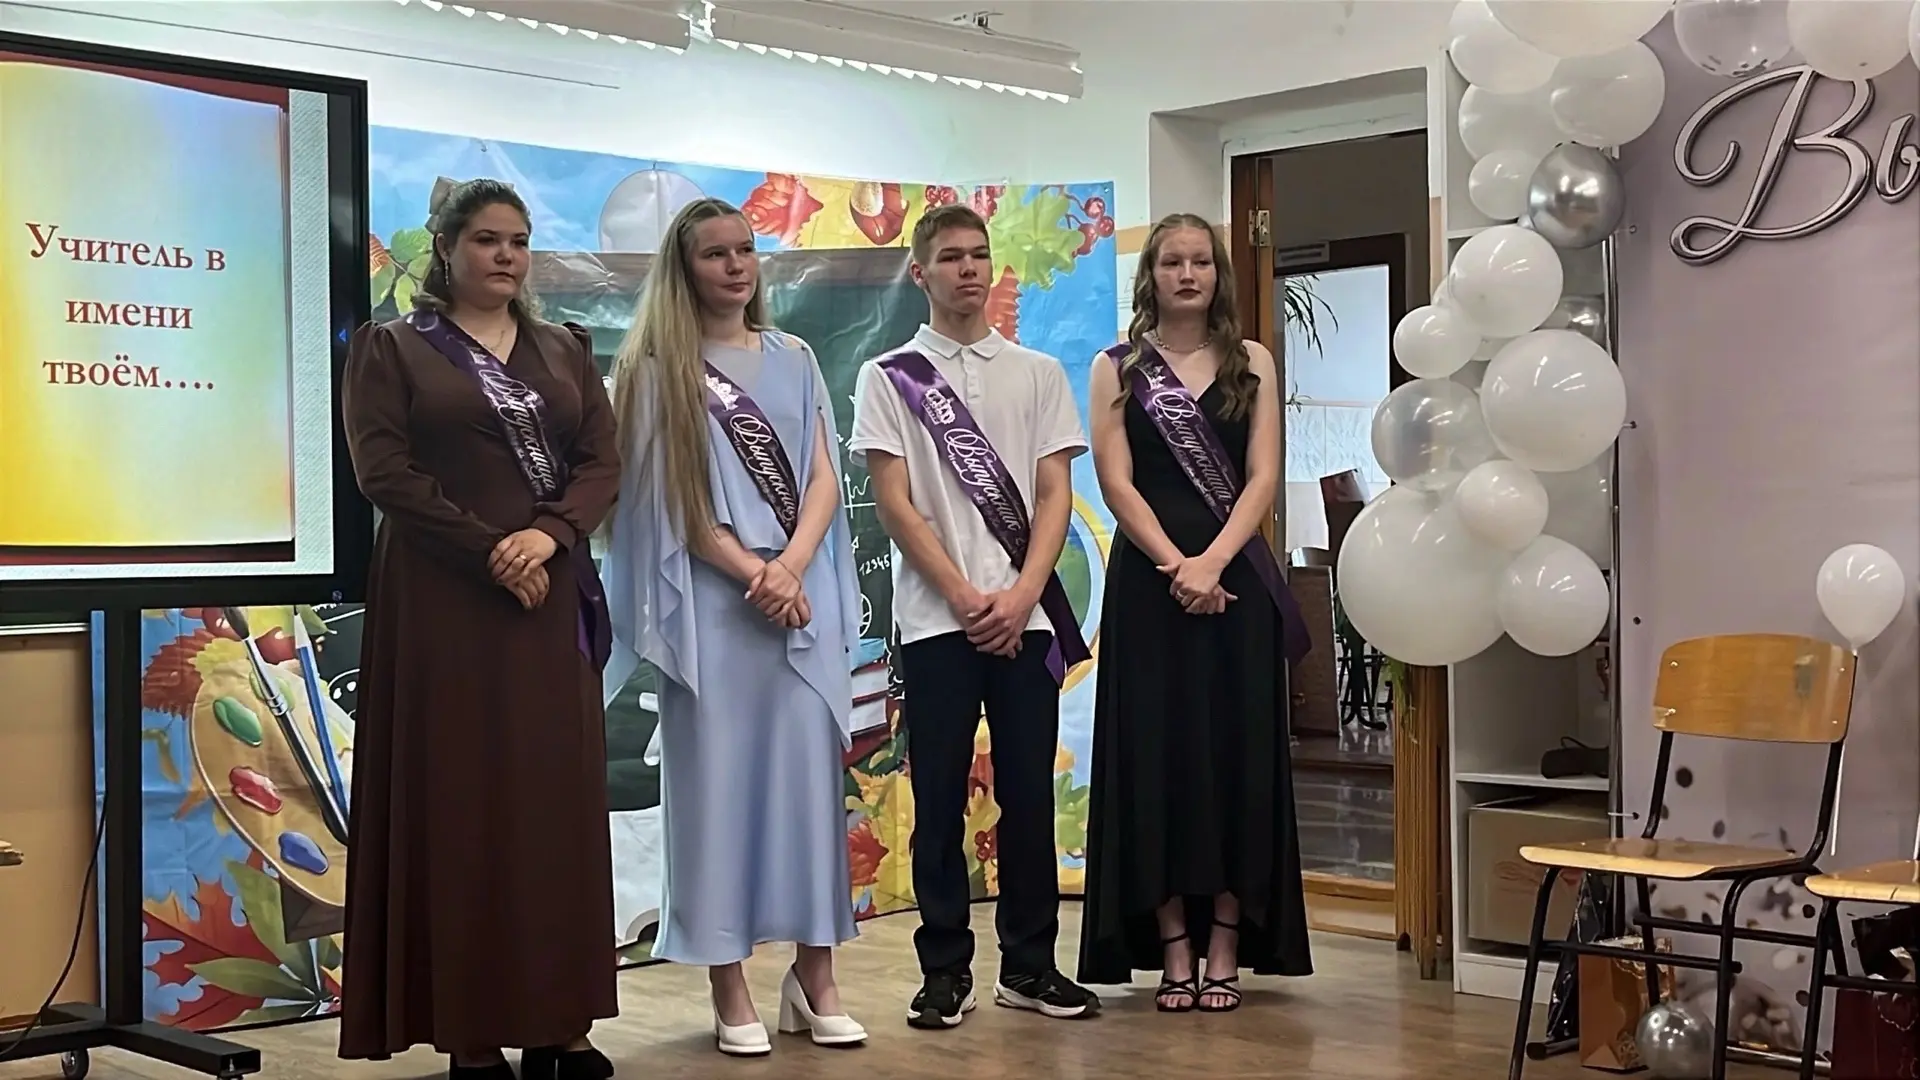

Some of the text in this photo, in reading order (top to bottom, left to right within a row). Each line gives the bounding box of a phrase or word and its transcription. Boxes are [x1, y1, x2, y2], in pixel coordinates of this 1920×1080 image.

[25, 222, 227, 271] Учитель в
[64, 300, 194, 330] имени
[42, 353, 214, 391] твоём....
[478, 369, 557, 492] Выпускница
[729, 413, 796, 521] Выпускниц
[1152, 391, 1234, 501] Выпускница
[943, 428, 1022, 531] Выпускник
[860, 554, 890, 576] 12345
